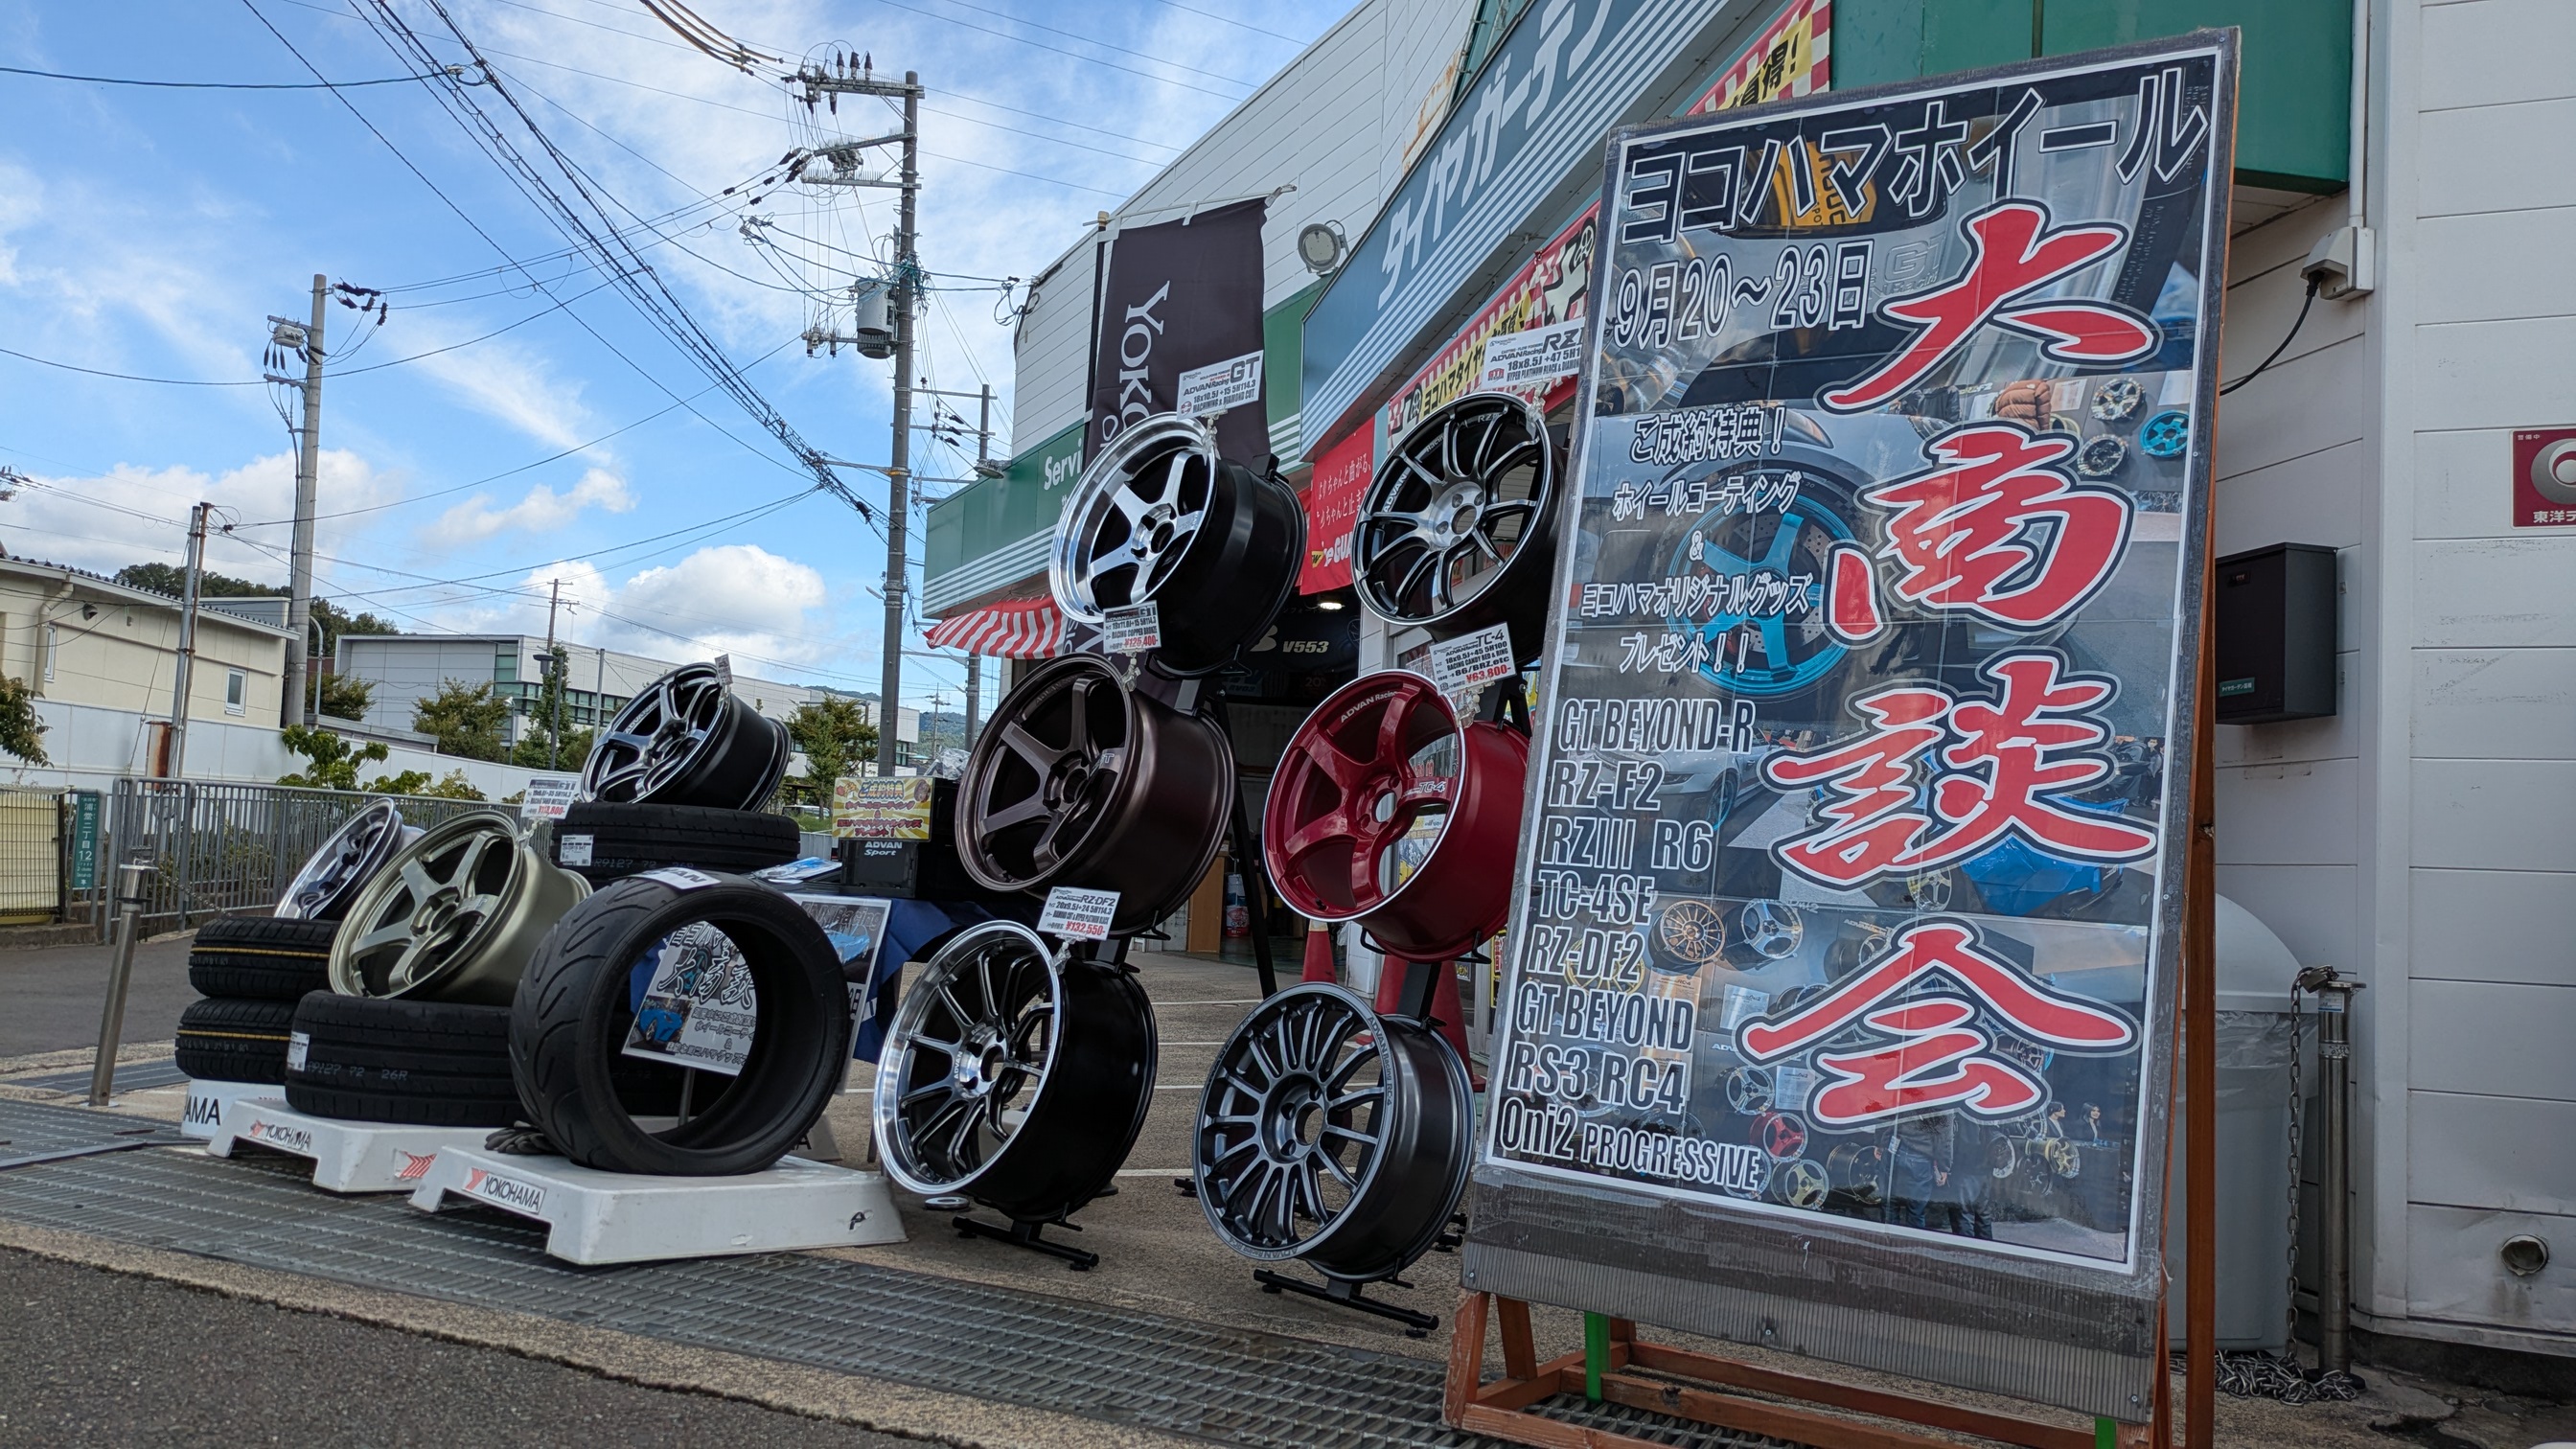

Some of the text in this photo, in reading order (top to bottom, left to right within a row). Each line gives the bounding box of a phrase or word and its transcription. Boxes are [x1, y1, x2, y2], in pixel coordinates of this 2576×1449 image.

[1622, 67, 2210, 245] ヨコハマホイール
[1230, 356, 1260, 383] GT
[1544, 351, 1561, 363] +47
[1630, 407, 1784, 466] ご成約特典！
[1382, 435, 1445, 513] ADVAN Racin
[1317, 488, 1368, 530] りちゃんと止ま
[1612, 471, 1802, 522] ホイールコーティング
[1689, 531, 1705, 562] &
[1581, 572, 1814, 620] ヨコハマオリジナルグッズ
[1282, 640, 1330, 653] V553
[1476, 629, 1505, 647] TC-4
[1620, 634, 1747, 676] プレゼント！！
[1341, 697, 1375, 724] ADVAN
[1558, 699, 1756, 755] GT BEYOND-R
[1548, 759, 1666, 812] RZ-F2
[79, 850, 93, 861] 12
[863, 848, 897, 857] Sport
[864, 840, 903, 849] ADVAN
[1650, 819, 1715, 873] R6
[1537, 869, 1656, 927] TC-4SE
[1528, 926, 1646, 984] RZ-DF2
[1368, 1017, 1388, 1052] ADVAN
[1517, 983, 1697, 1054] GT BEYOND
[954, 1051, 964, 1080] ADVAN
[1507, 1041, 1689, 1116] RS3 RC4
[1499, 1097, 1763, 1191] Oni2 PROGRESSIVE
[482, 1173, 544, 1211] YOKOHAMA
